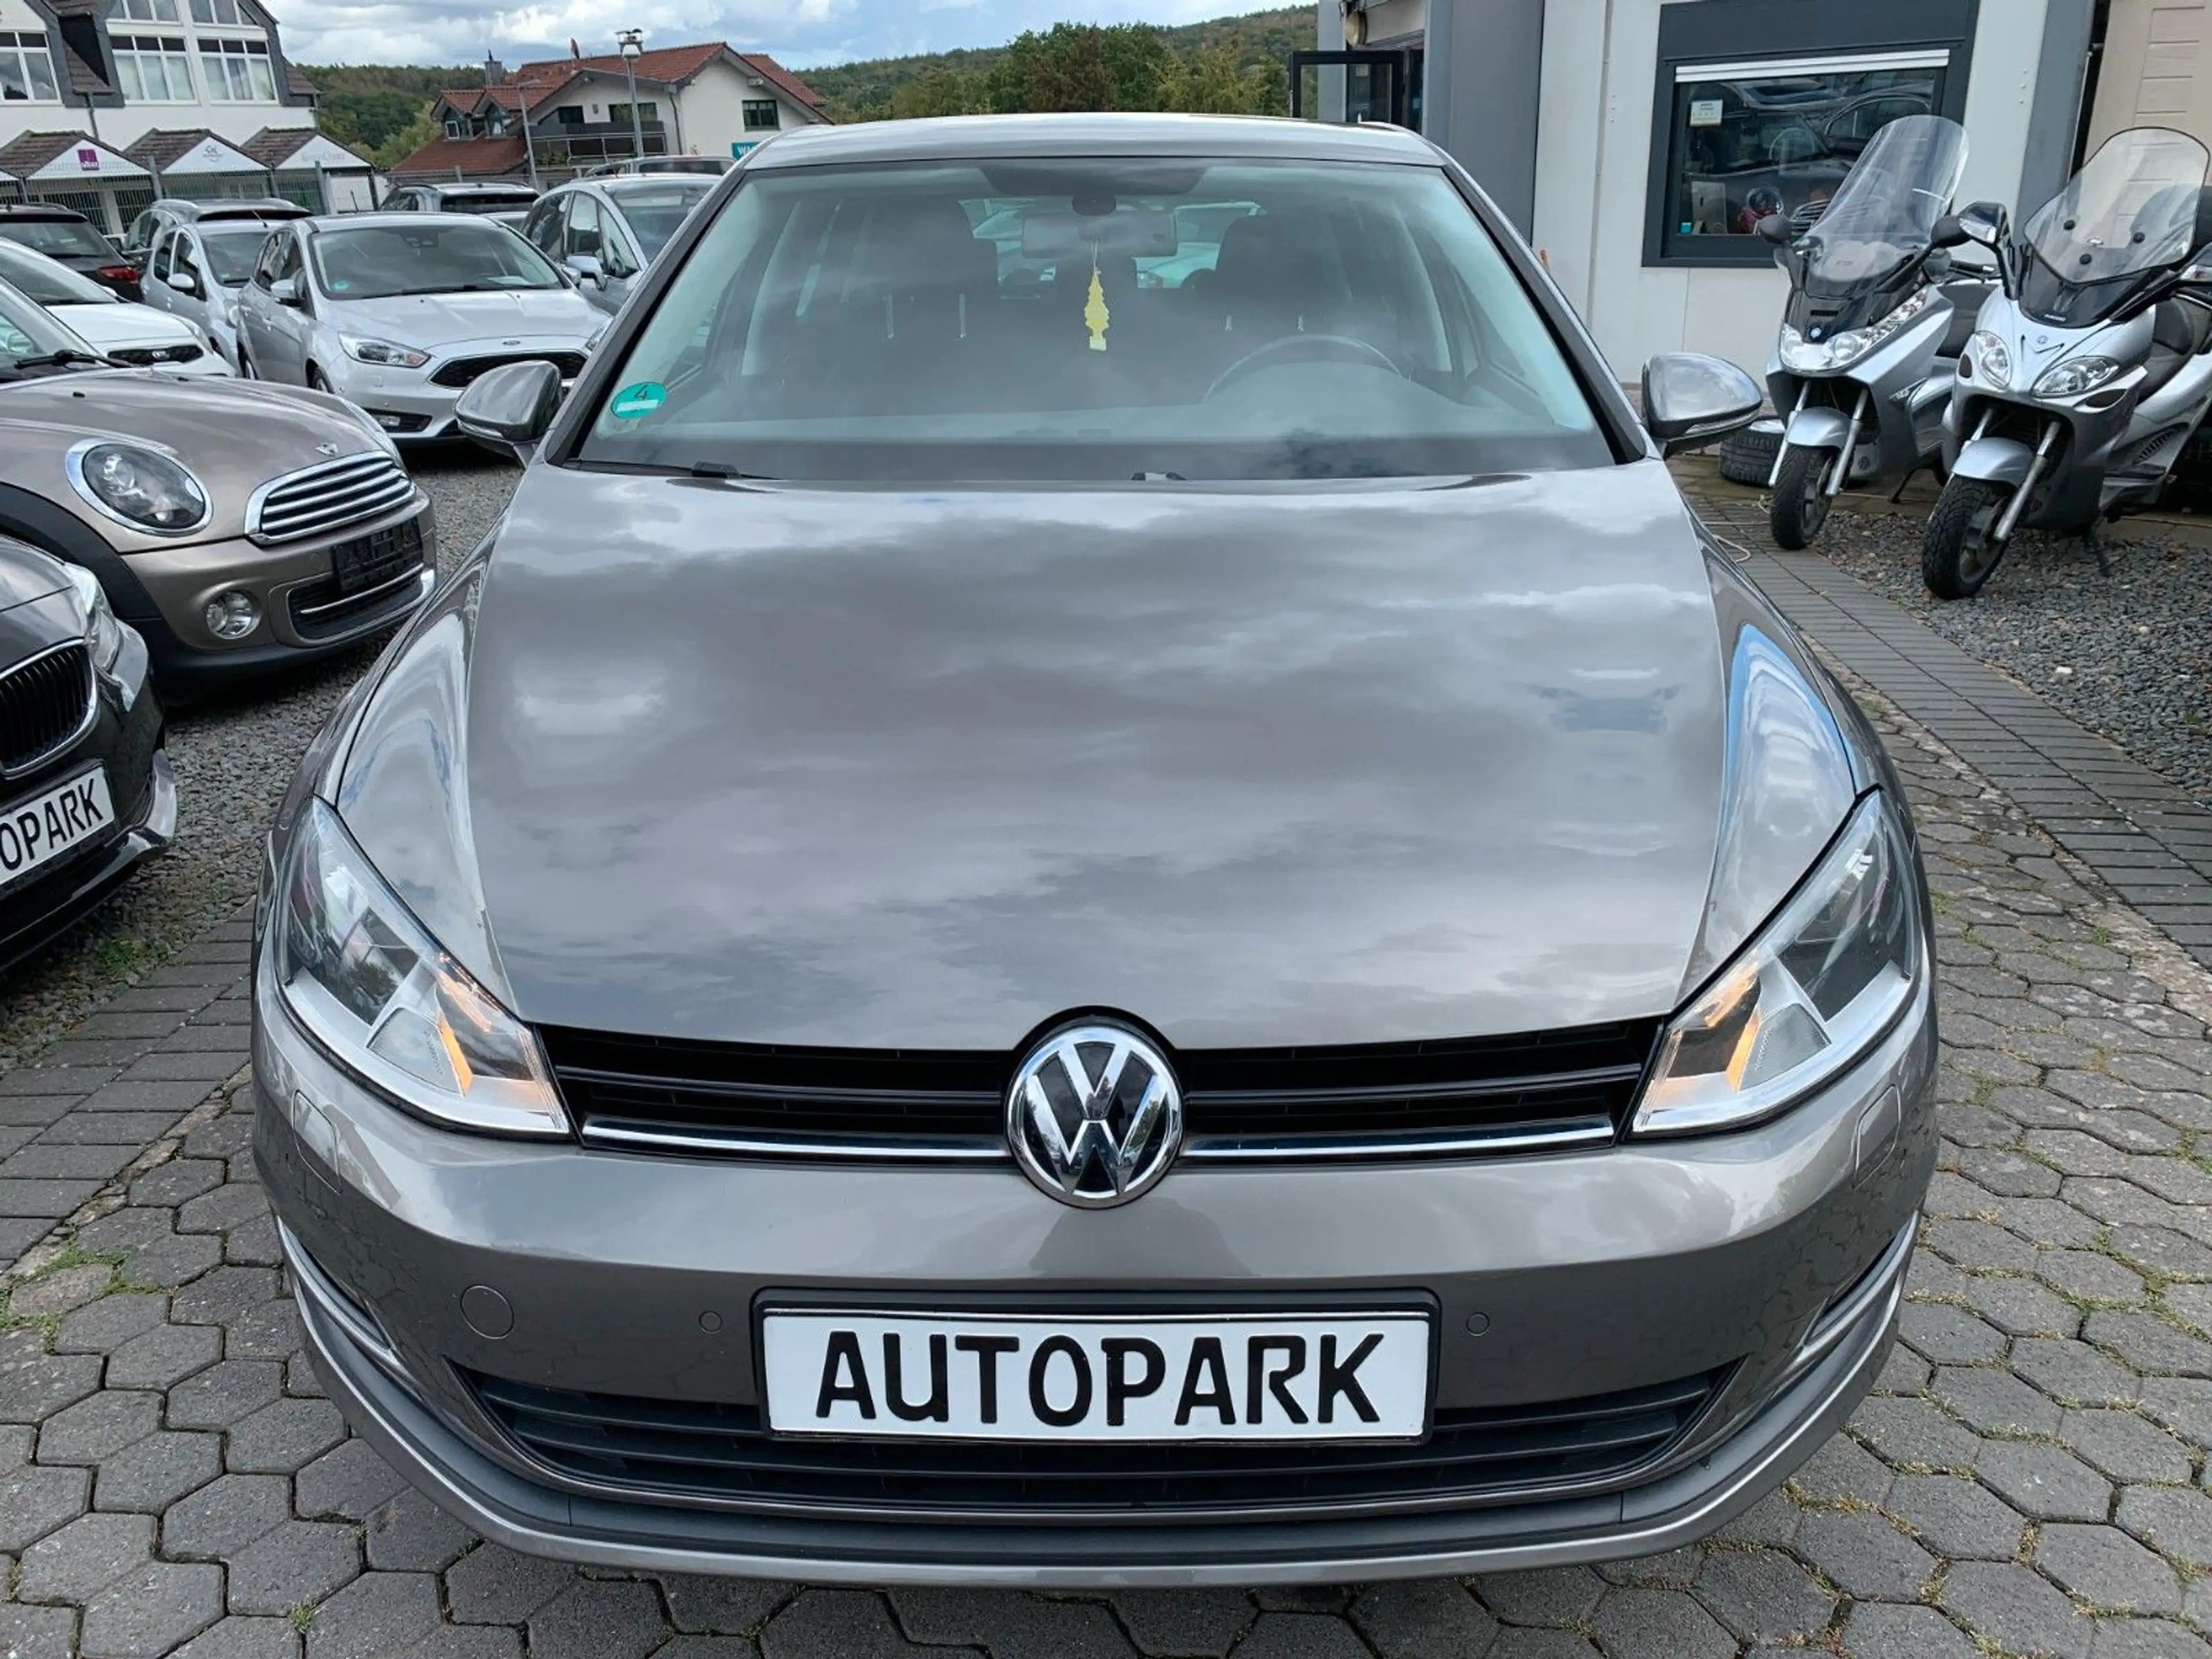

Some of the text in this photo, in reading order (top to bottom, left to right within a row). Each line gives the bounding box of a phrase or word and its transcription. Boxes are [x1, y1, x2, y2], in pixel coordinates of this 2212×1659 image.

[634, 384, 648, 399] 4
[0, 779, 103, 870] OPARK
[1021, 1036, 1171, 1198] VW
[816, 1331, 1384, 1427] AUTOPARK
